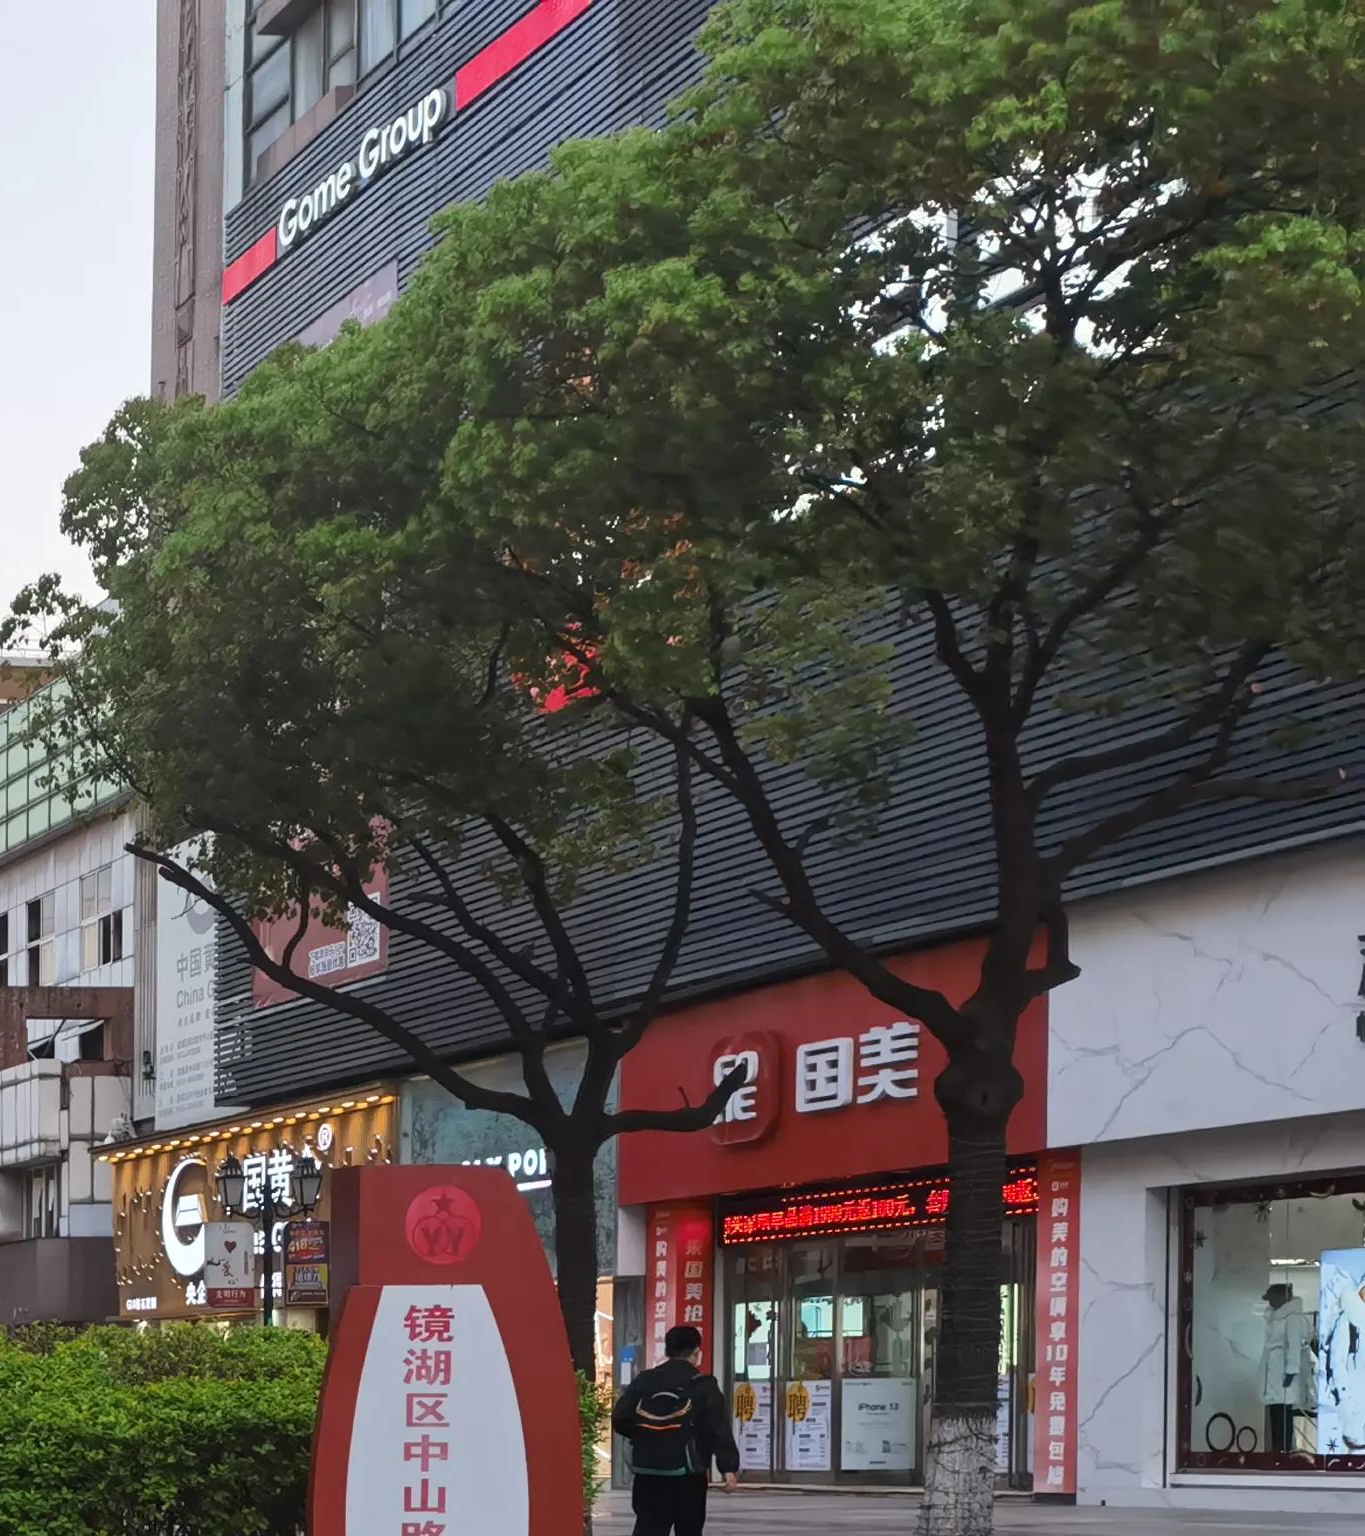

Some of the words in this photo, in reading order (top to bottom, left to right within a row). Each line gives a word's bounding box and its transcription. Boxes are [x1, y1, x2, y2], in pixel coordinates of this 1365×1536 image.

[279, 162, 351, 246] Gome
[359, 89, 444, 179] Group
[795, 1022, 920, 1112] 国美
[858, 1403, 886, 1411] iPhone
